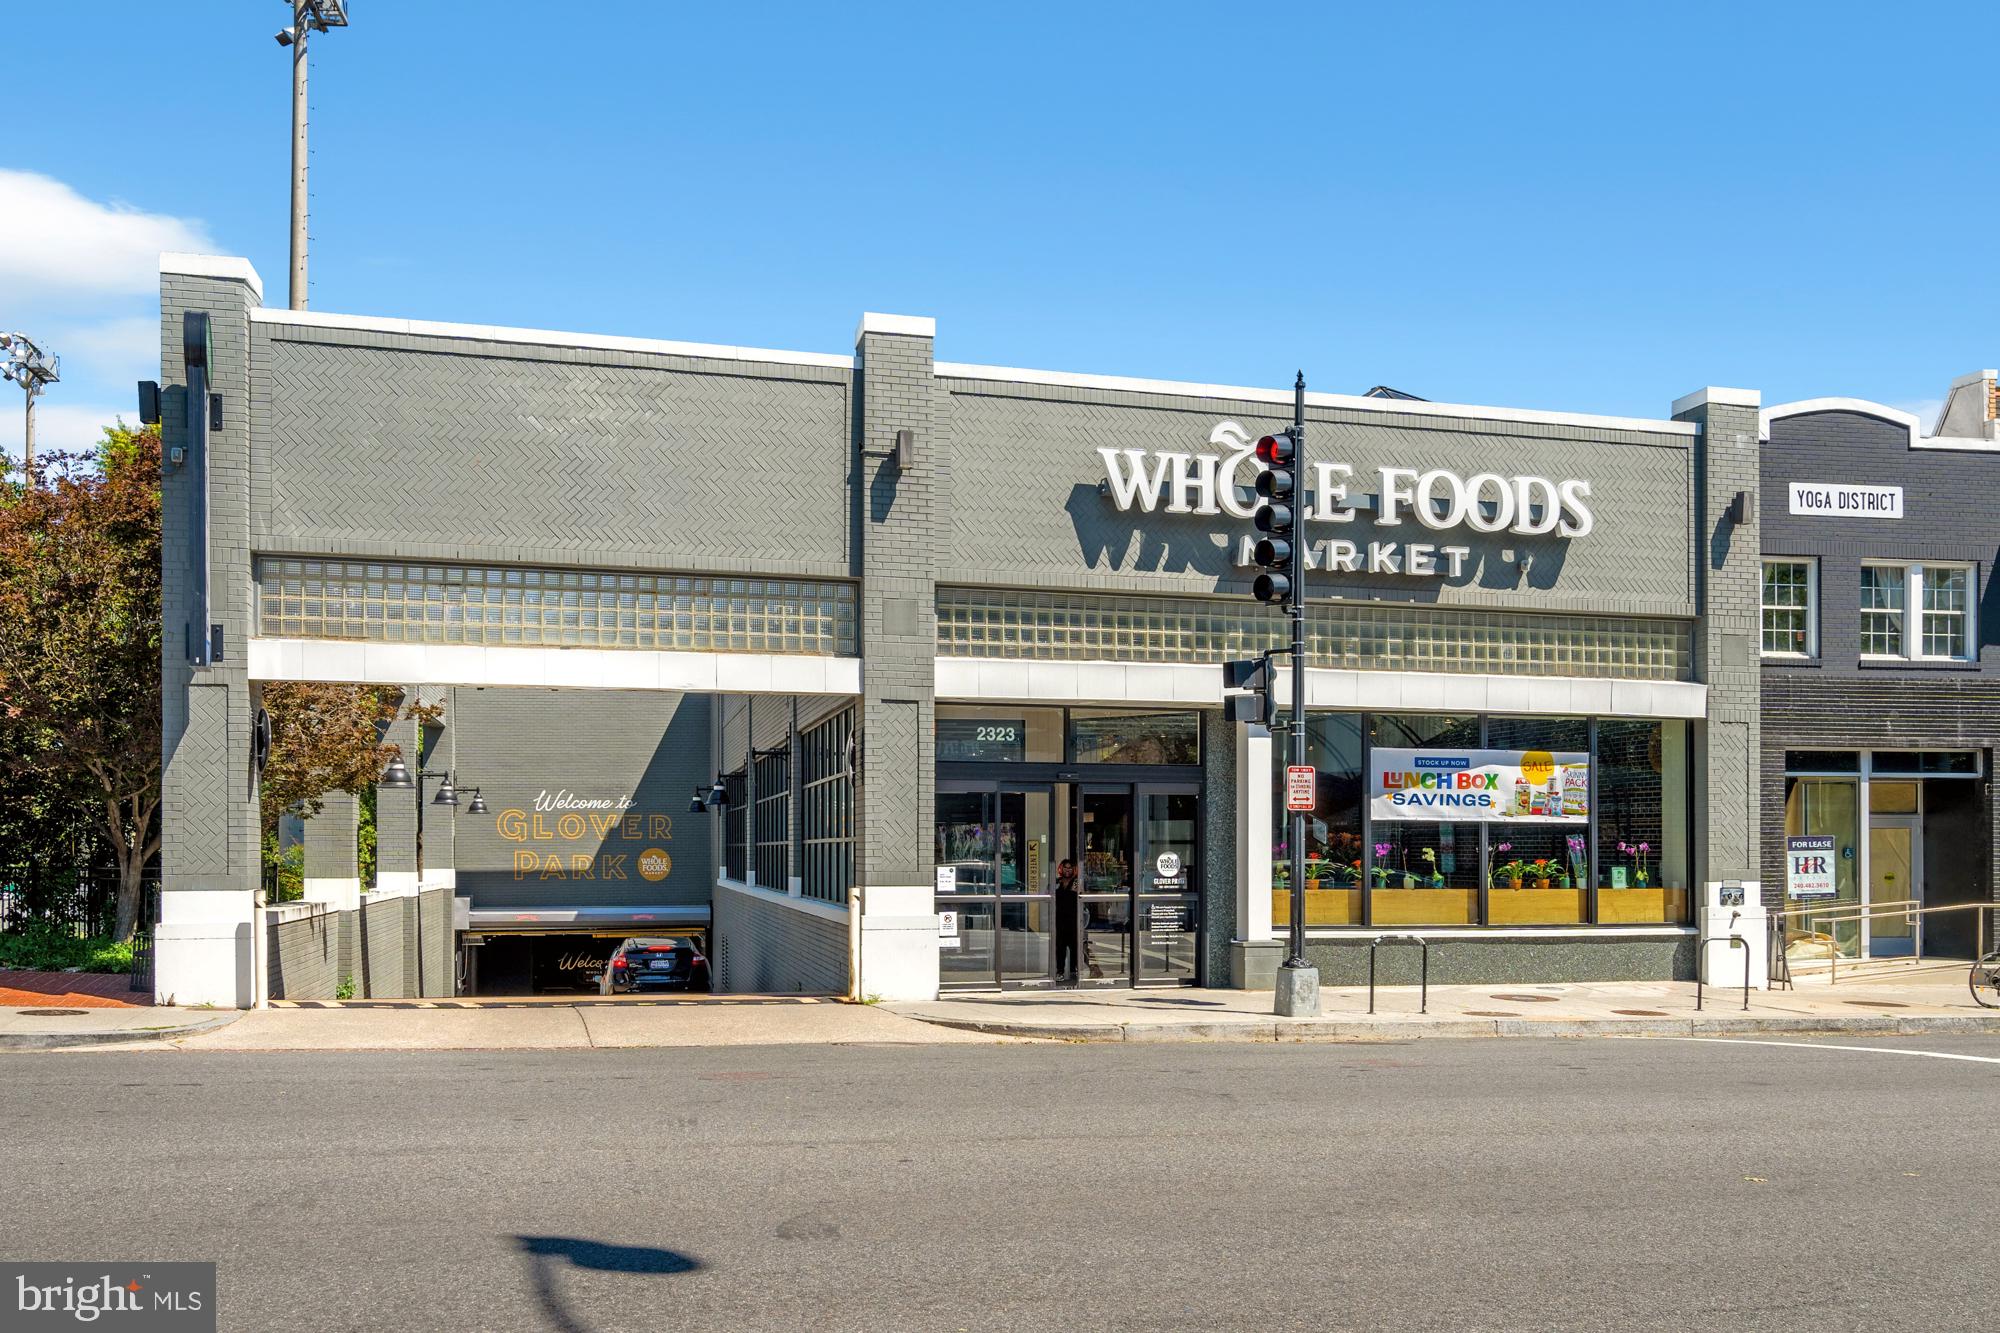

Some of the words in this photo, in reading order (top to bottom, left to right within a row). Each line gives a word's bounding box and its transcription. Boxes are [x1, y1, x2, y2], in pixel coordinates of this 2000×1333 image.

[1097, 420, 1355, 521] WHOE
[1374, 466, 1593, 538] FOODS
[1797, 490, 1832, 508] YOGA
[1838, 491, 1895, 511] DISTRICT
[976, 726, 1015, 741] 2323
[1523, 760, 1552, 772] SALE
[1383, 771, 1453, 789] LUNCH
[1457, 772, 1499, 790] BOX
[532, 789, 613, 812] Welcome
[615, 794, 638, 809] to
[1392, 793, 1491, 807] SAVINGS
[496, 809, 673, 843] GLOVER
[1808, 840, 1832, 848] LEASE
[514, 849, 628, 881] PARK
[641, 856, 668, 865] WHOLE
[642, 864, 667, 872] FOODS
[557, 951, 605, 971] Welco
